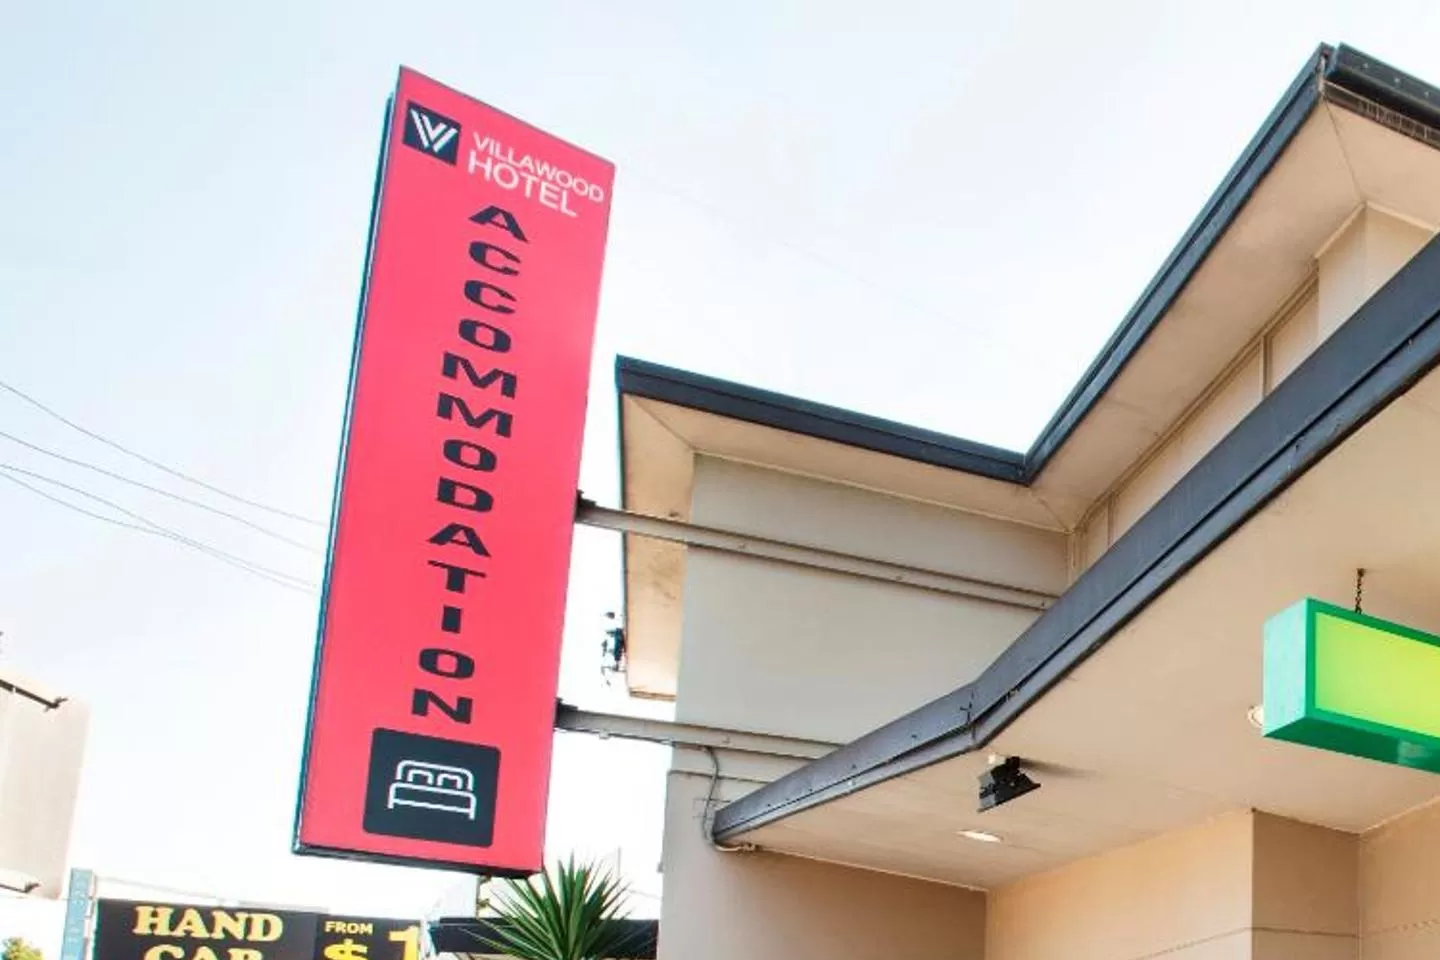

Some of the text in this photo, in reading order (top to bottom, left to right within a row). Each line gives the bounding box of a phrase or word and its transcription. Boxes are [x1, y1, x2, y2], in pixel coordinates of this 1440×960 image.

[468, 153, 578, 217] HOTEL
[472, 132, 604, 203] VILLAWOOD
[411, 205, 529, 725] ACCOMMODATION
[131, 905, 284, 942] HAND
[324, 920, 373, 936] FROM
